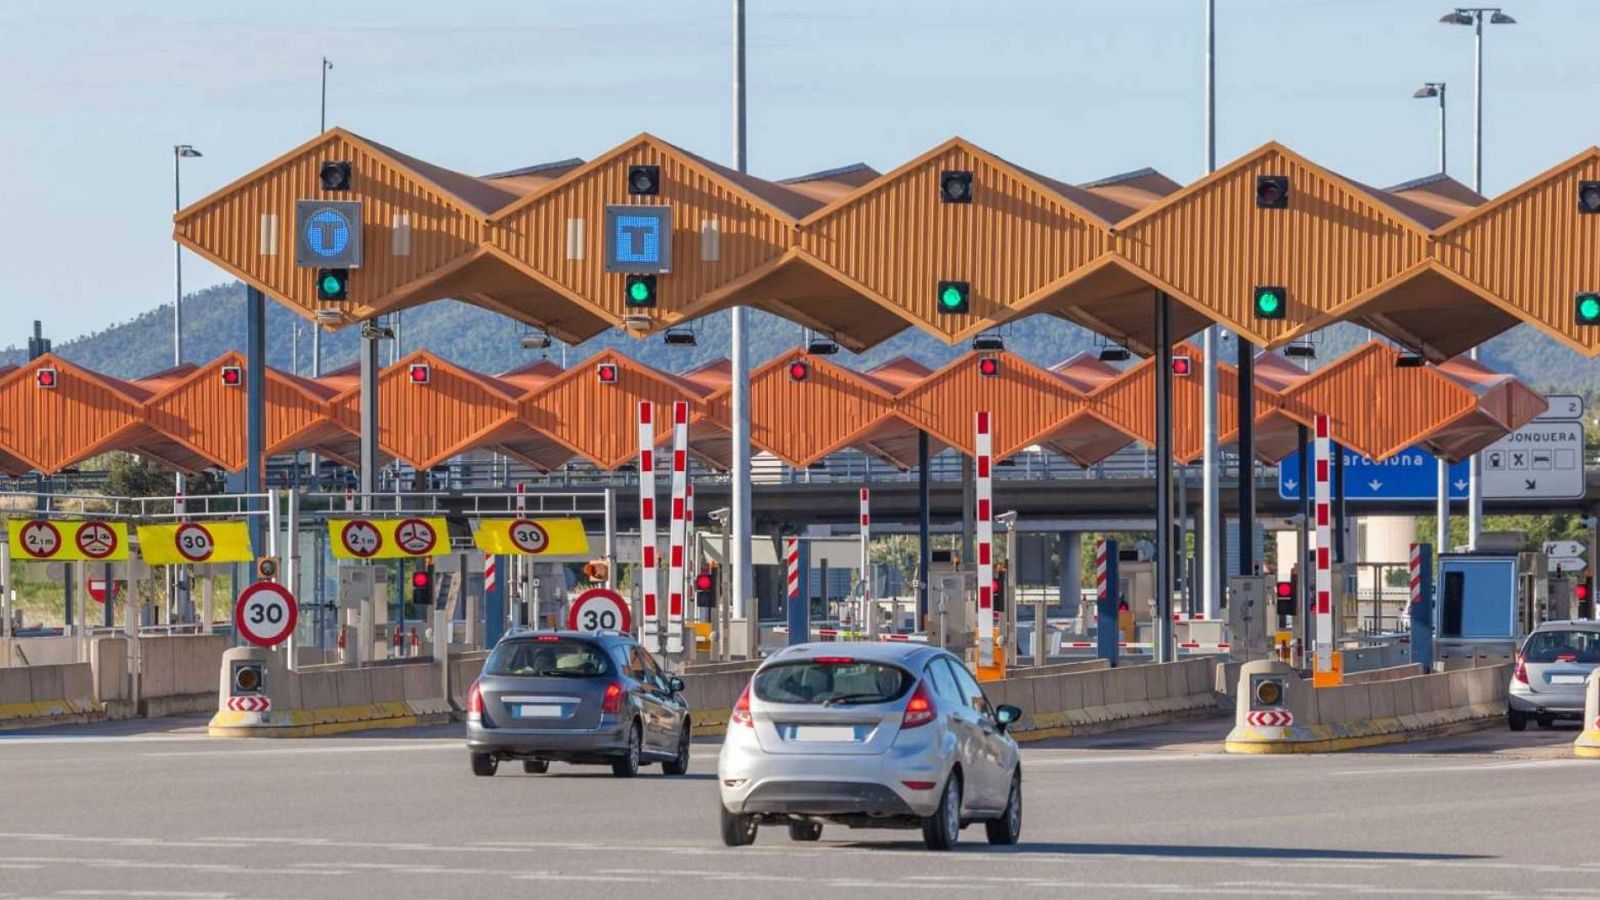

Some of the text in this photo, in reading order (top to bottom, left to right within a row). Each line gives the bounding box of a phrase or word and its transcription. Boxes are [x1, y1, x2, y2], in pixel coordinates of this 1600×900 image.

[623, 226, 655, 256] T
[1568, 402, 1577, 412] 2
[1508, 432, 1576, 442] JONQUERA
[183, 536, 206, 549] 30
[517, 530, 540, 543] 30
[250, 603, 283, 624] 30
[583, 610, 616, 631] 30
